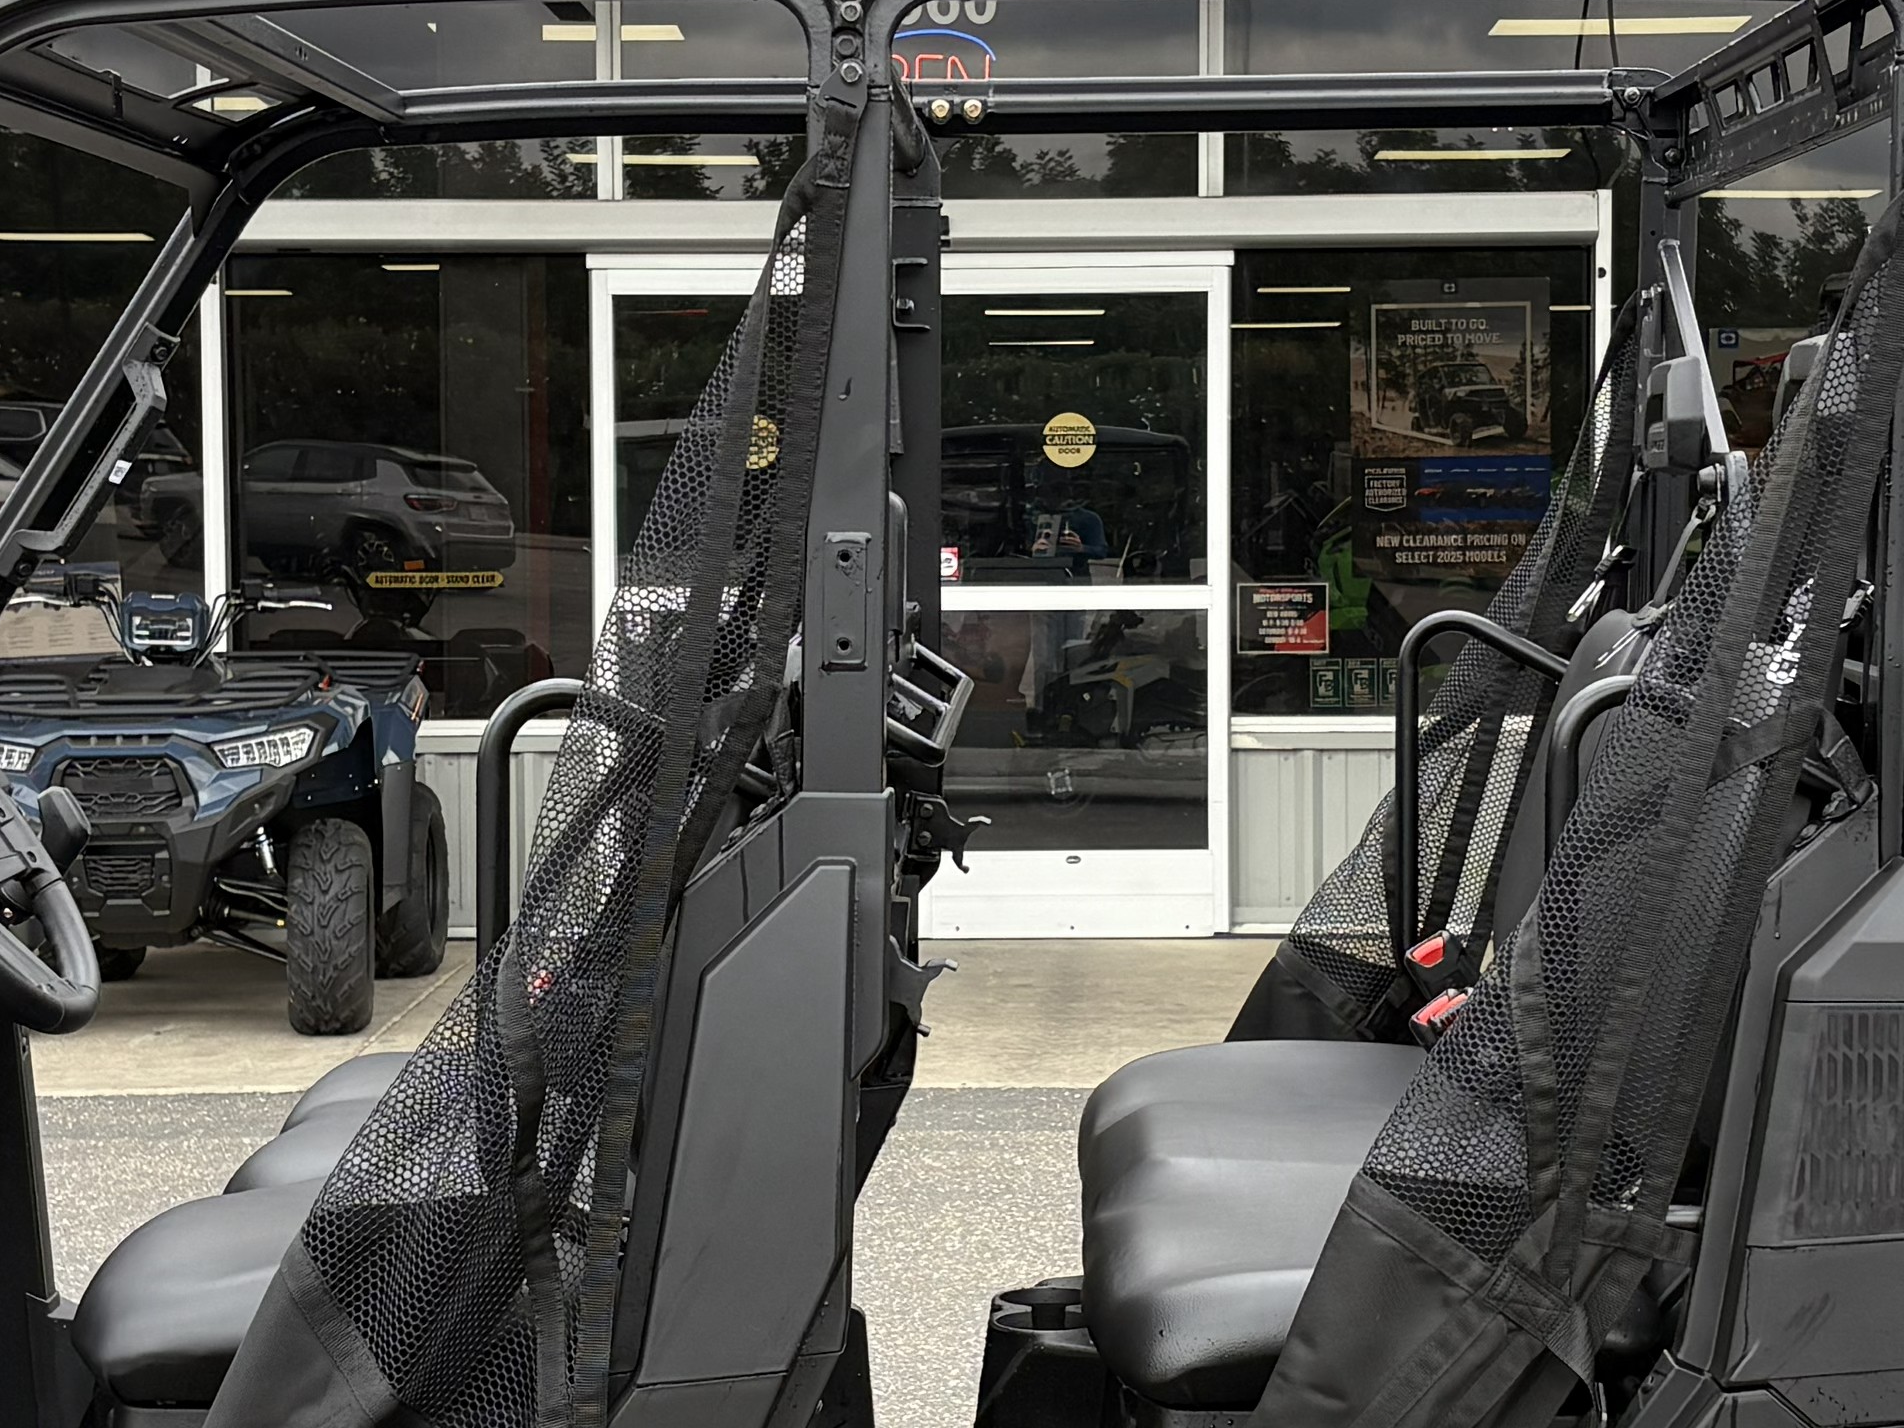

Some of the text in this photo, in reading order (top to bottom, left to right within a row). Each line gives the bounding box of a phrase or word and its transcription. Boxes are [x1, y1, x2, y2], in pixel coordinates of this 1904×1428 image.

[1411, 320, 1446, 331] BUILT
[1451, 319, 1466, 330] TO
[1398, 334, 1443, 346] PRICED
[1447, 333, 1462, 345] TO
[1045, 435, 1094, 445] CAUTION
[1058, 447, 1081, 455] DOOR
[1369, 479, 1401, 488] FACTORY
[1376, 533, 1526, 548] NEW CLEARANCE PRICING ON
[1396, 550, 1506, 564] SELECT 2025 MODELS
[473, 573, 496, 584] CLEAR
